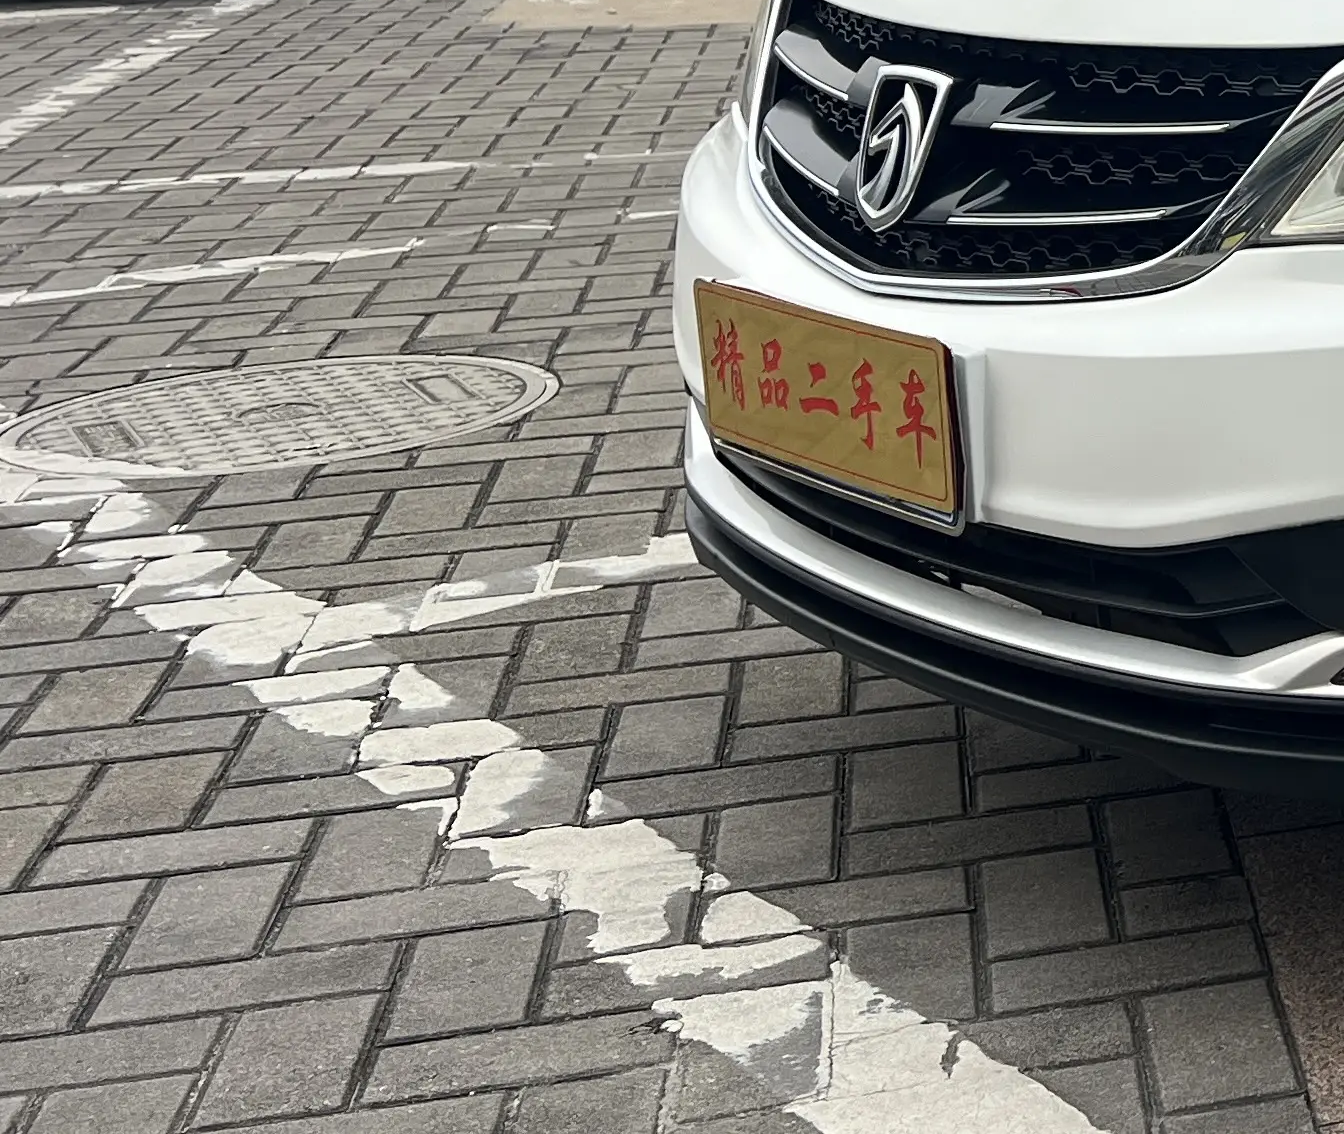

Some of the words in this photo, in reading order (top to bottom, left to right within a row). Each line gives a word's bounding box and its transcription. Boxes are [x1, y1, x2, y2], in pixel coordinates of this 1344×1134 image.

[711, 318, 937, 469] 精品二手车
